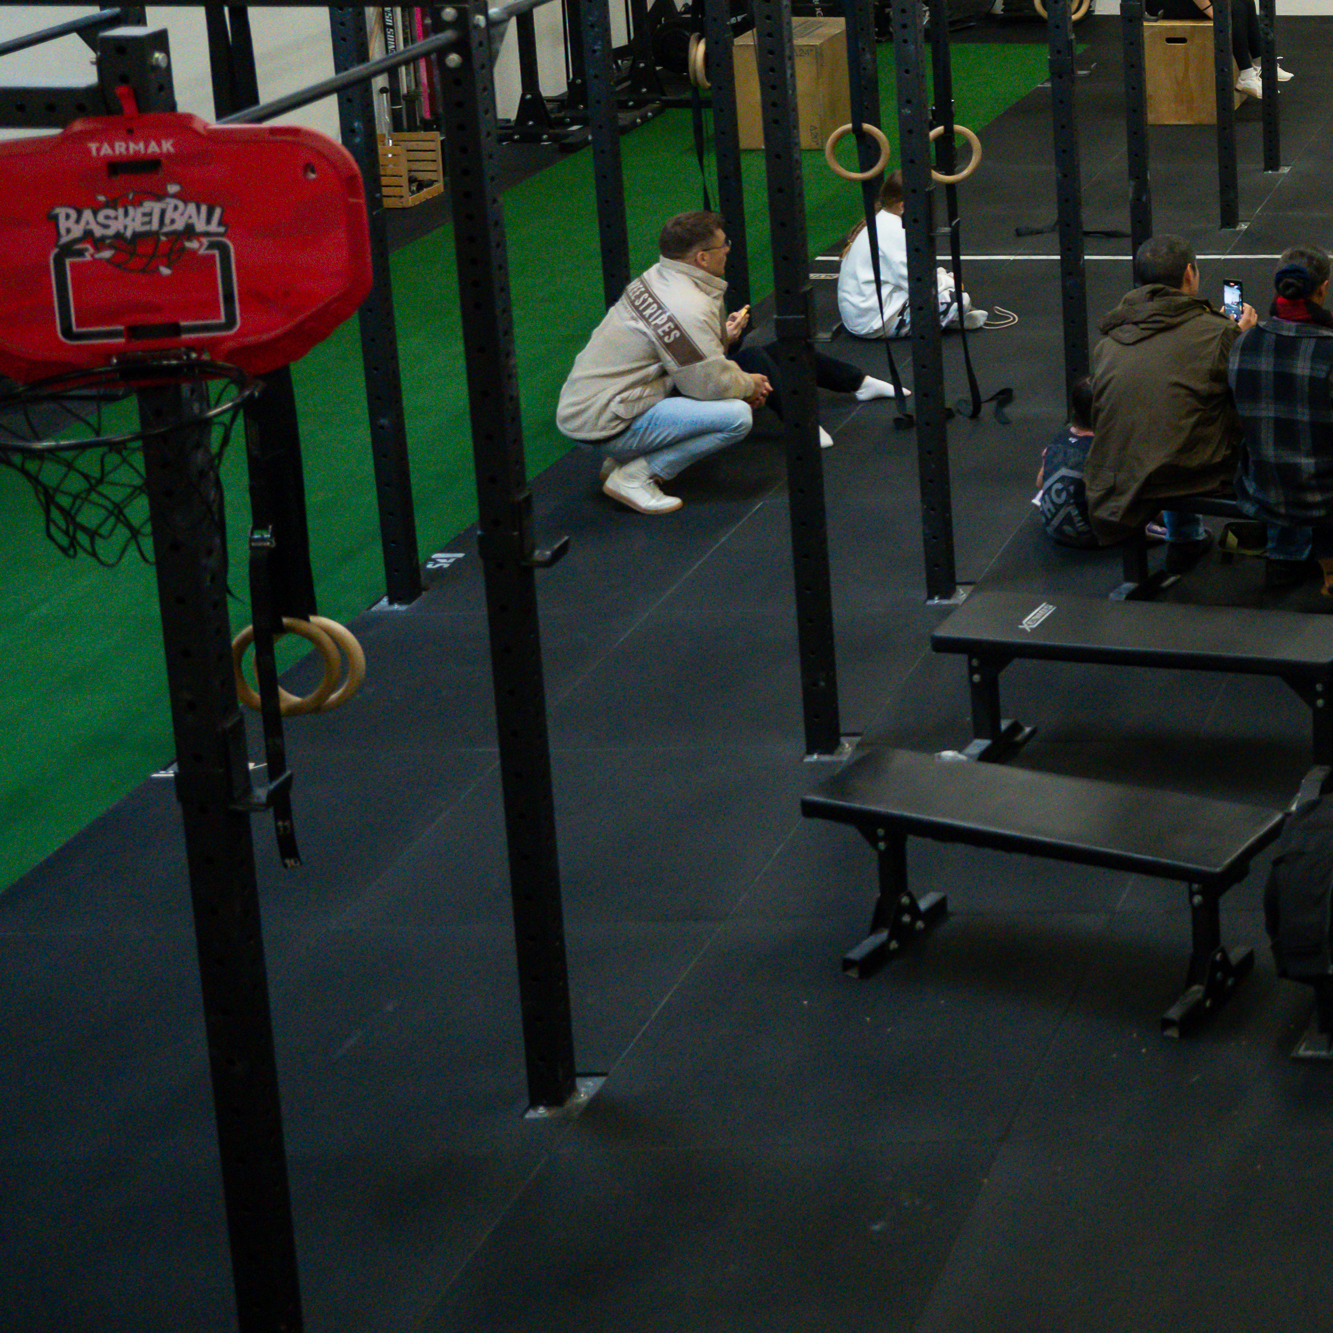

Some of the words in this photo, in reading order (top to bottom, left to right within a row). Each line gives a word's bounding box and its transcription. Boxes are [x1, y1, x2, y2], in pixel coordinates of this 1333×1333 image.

[88, 138, 175, 157] TARMAK
[49, 197, 229, 243] BASKETBALL
[632, 291, 681, 344] STRIPES
